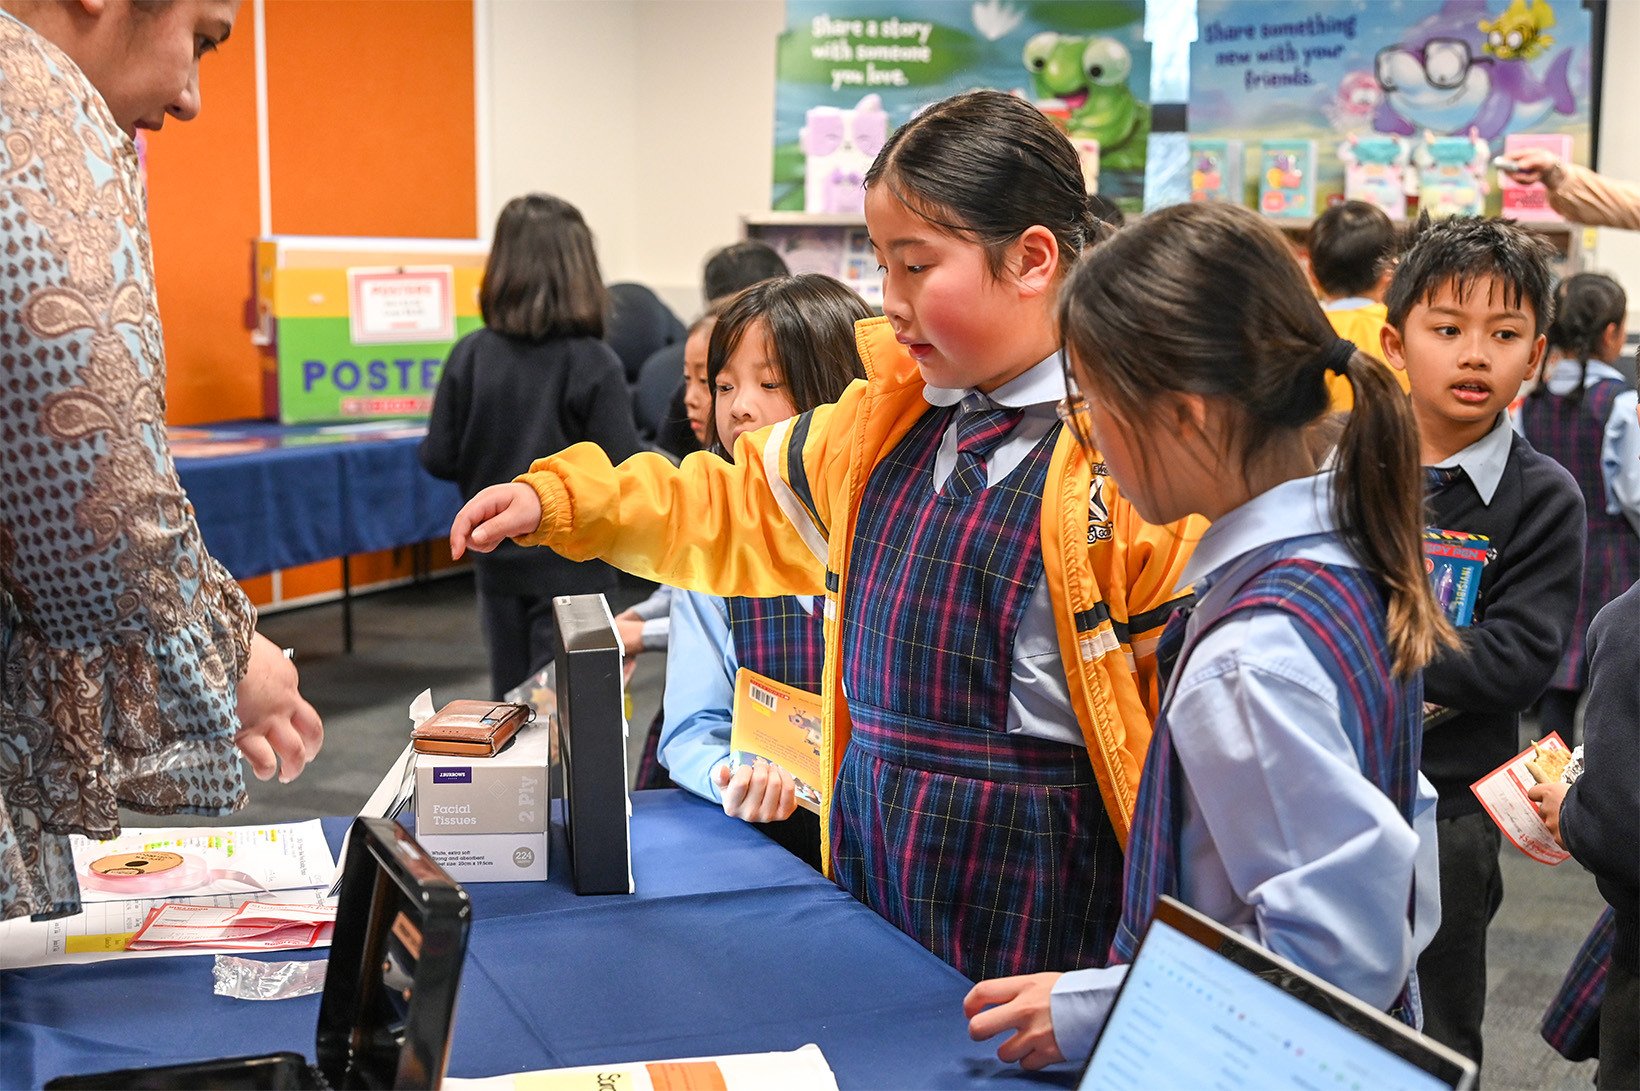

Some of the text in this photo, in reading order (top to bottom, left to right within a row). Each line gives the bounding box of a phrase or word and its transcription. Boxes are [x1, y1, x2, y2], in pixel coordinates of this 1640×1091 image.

[811, 13, 932, 45] Share a story
[1204, 13, 1356, 44] Share something
[811, 37, 931, 62] with someone
[1215, 40, 1345, 67] new with your
[831, 62, 909, 91] you love.
[1245, 66, 1312, 91] friends.
[1455, 566, 1471, 606] INVISIBLE
[433, 804, 471, 814] Facial
[519, 775, 538, 822] 2 Ply
[433, 816, 477, 825] Tissues
[516, 852, 531, 860] 224
